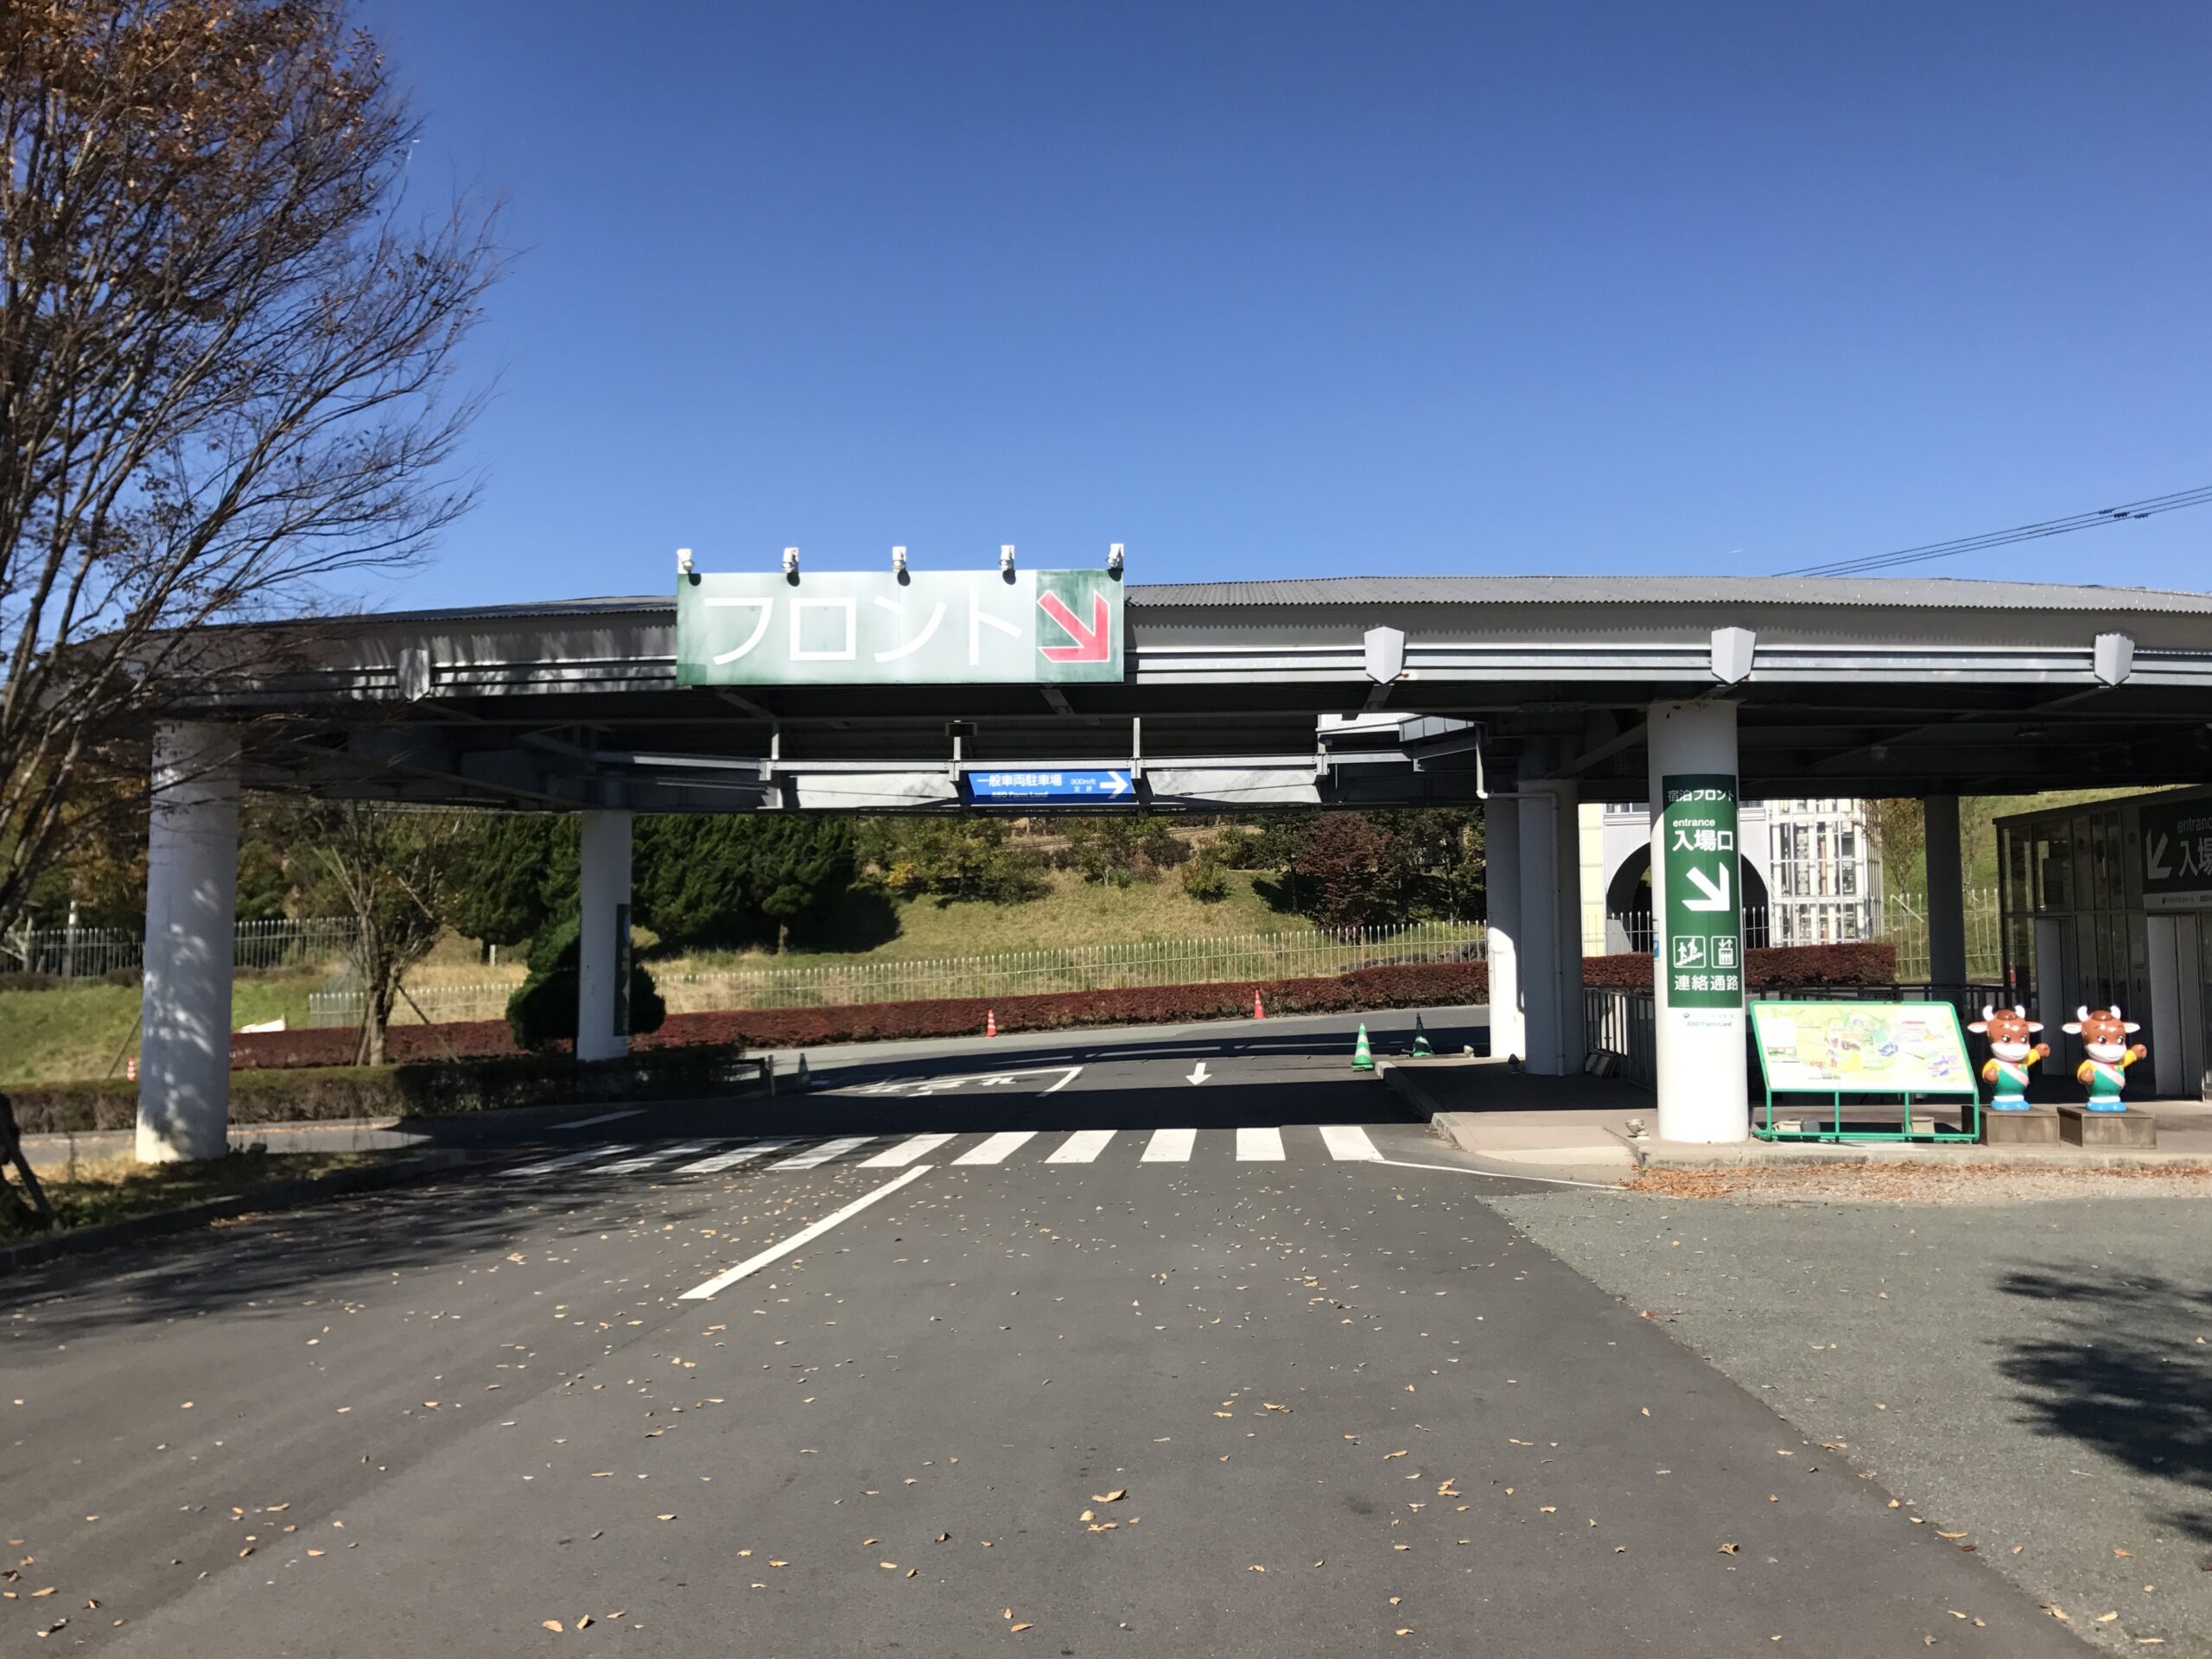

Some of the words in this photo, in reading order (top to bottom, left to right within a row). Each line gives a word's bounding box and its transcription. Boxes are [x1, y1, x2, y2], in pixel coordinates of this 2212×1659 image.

[703, 588, 1023, 665] フロント
[976, 773, 1063, 787] 一般車両駐車場
[1668, 789, 1734, 802] 宿泊フロント
[1673, 818, 1716, 828] entrance
[1672, 830, 1733, 852] 入場口
[1674, 975, 1738, 991] 連絡通路
